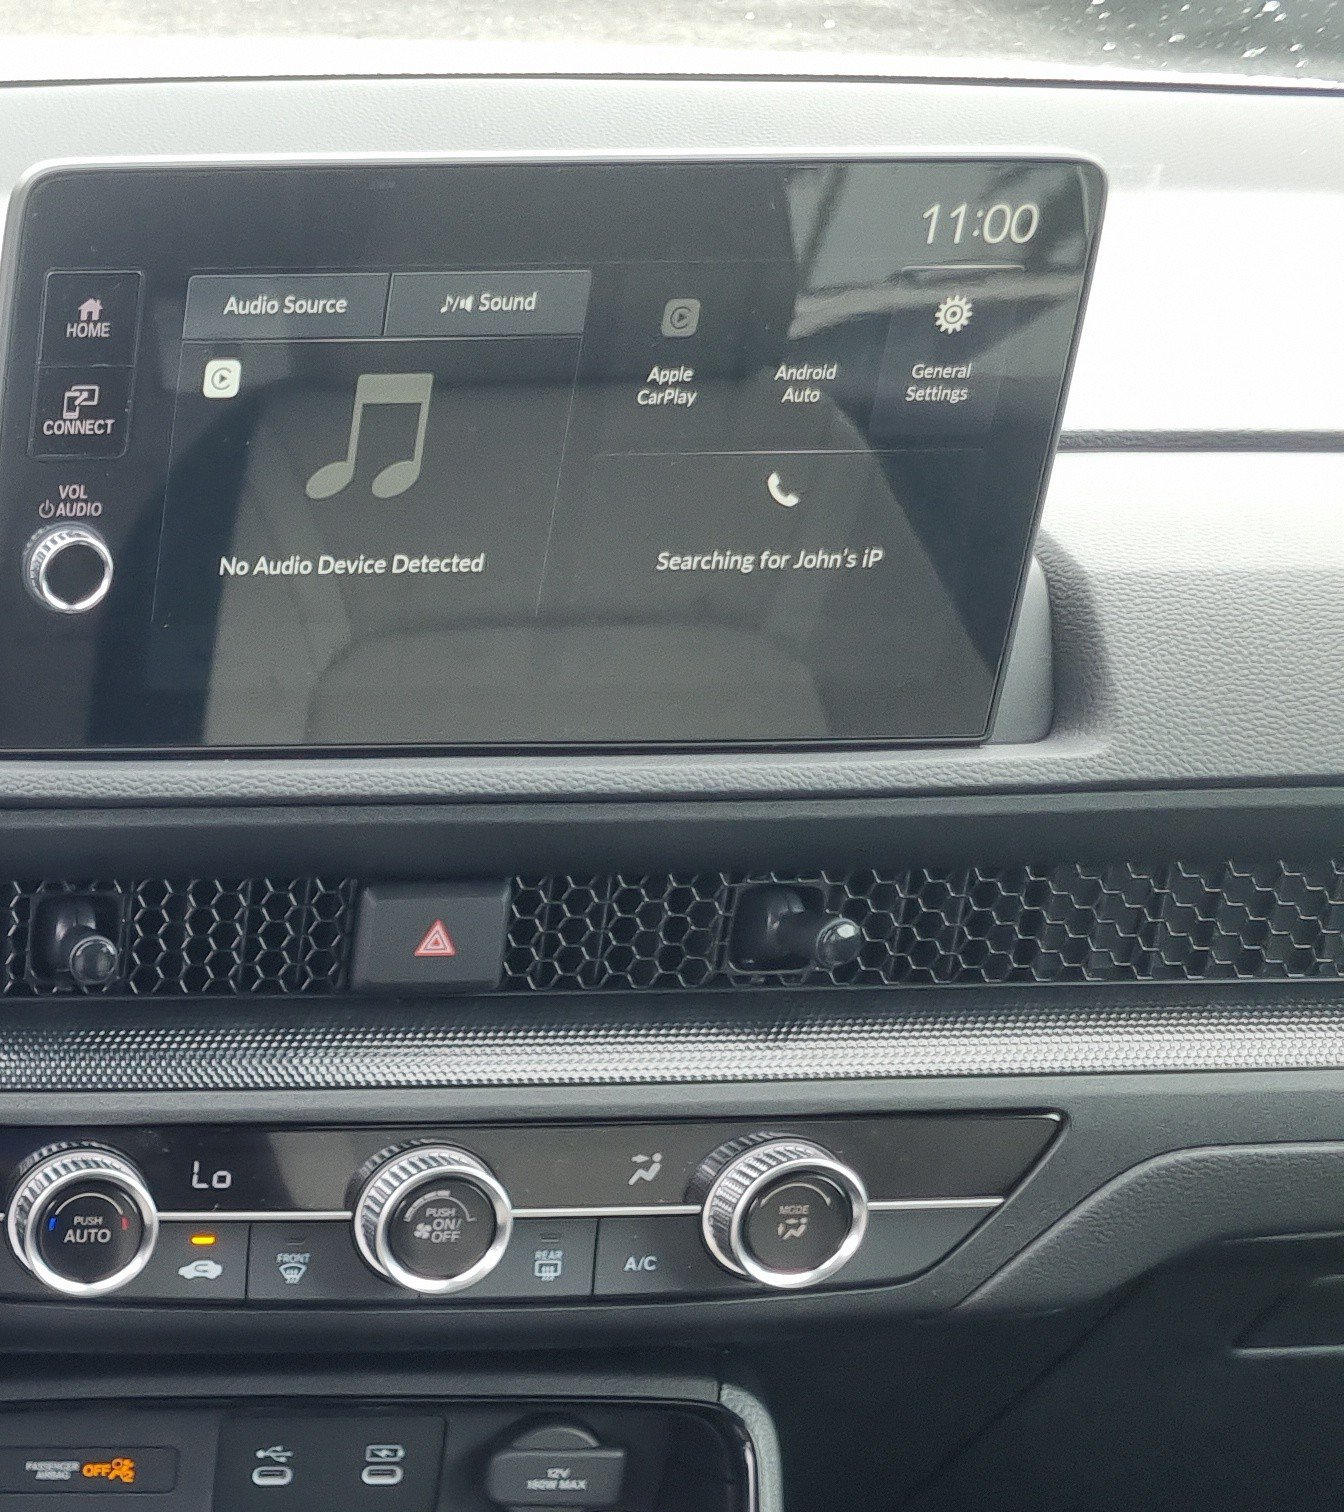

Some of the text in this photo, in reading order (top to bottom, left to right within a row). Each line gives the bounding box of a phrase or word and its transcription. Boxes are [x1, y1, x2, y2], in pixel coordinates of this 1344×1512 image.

[922, 202, 1039, 245] 11:00
[223, 294, 348, 316] Audio Source
[478, 291, 538, 312] Sound
[66, 321, 111, 339] HOME
[647, 364, 694, 385] Apple
[774, 363, 837, 382] Android
[911, 362, 972, 381] General
[637, 387, 697, 408] CarPlay
[781, 386, 821, 404] Auto
[905, 384, 969, 405] Settings
[42, 418, 114, 437] CONNECT
[58, 484, 88, 501] VOL
[56, 501, 102, 518] AUDIO
[219, 552, 486, 576] No Audio Device Detected
[655, 547, 885, 574] Searching for John's iP
[190, 1160, 232, 1191] Lo
[426, 1207, 456, 1217] PUSH
[779, 1204, 810, 1215] MODE
[73, 1215, 104, 1226] PUSH
[63, 1228, 112, 1243] AUTO
[431, 1230, 461, 1243] OFF
[276, 1252, 311, 1263] FRONT
[535, 1249, 564, 1260] REAR
[623, 1255, 658, 1272] A/C
[81, 1462, 113, 1478] OFF
[558, 1479, 589, 1491] MAX
